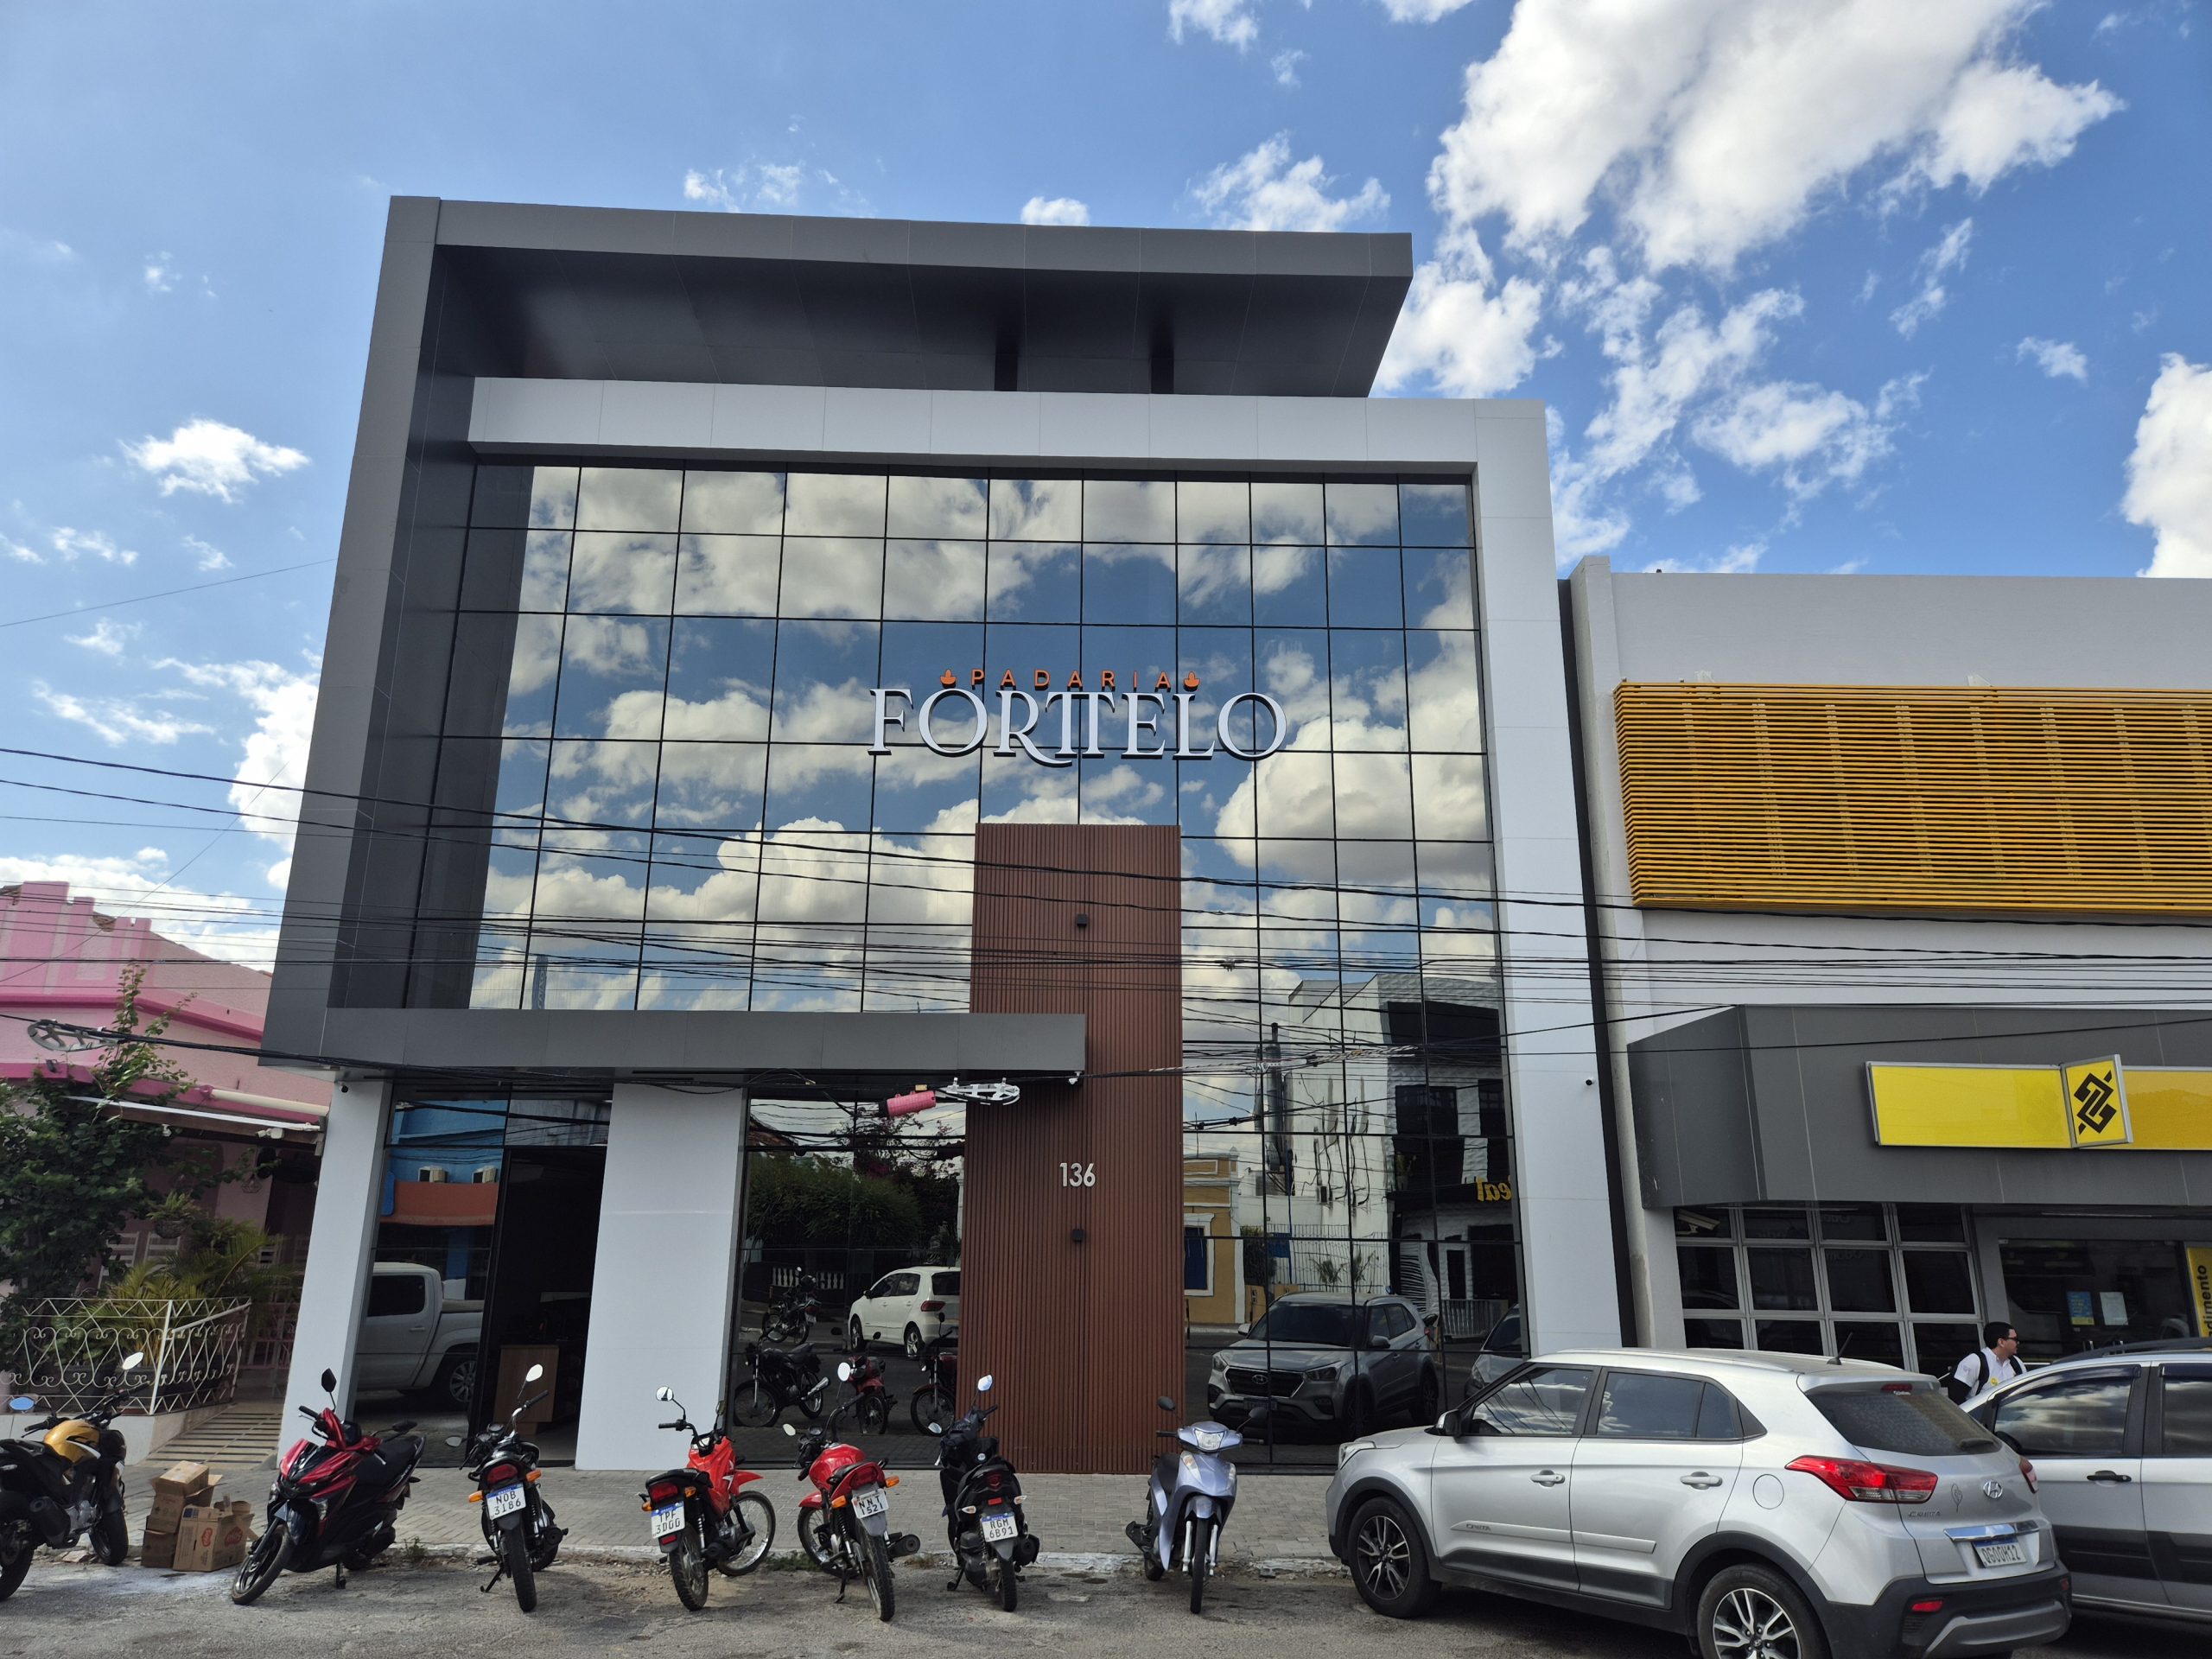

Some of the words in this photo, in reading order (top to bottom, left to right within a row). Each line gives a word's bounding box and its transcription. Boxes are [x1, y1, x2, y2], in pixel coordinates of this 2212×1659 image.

[971, 669, 1172, 691] PADARIA
[1059, 1162, 1096, 1187] 136
[494, 1498, 521, 1516] 3186
[859, 1496, 880, 1508] NNT
[861, 1503, 883, 1516] 1521
